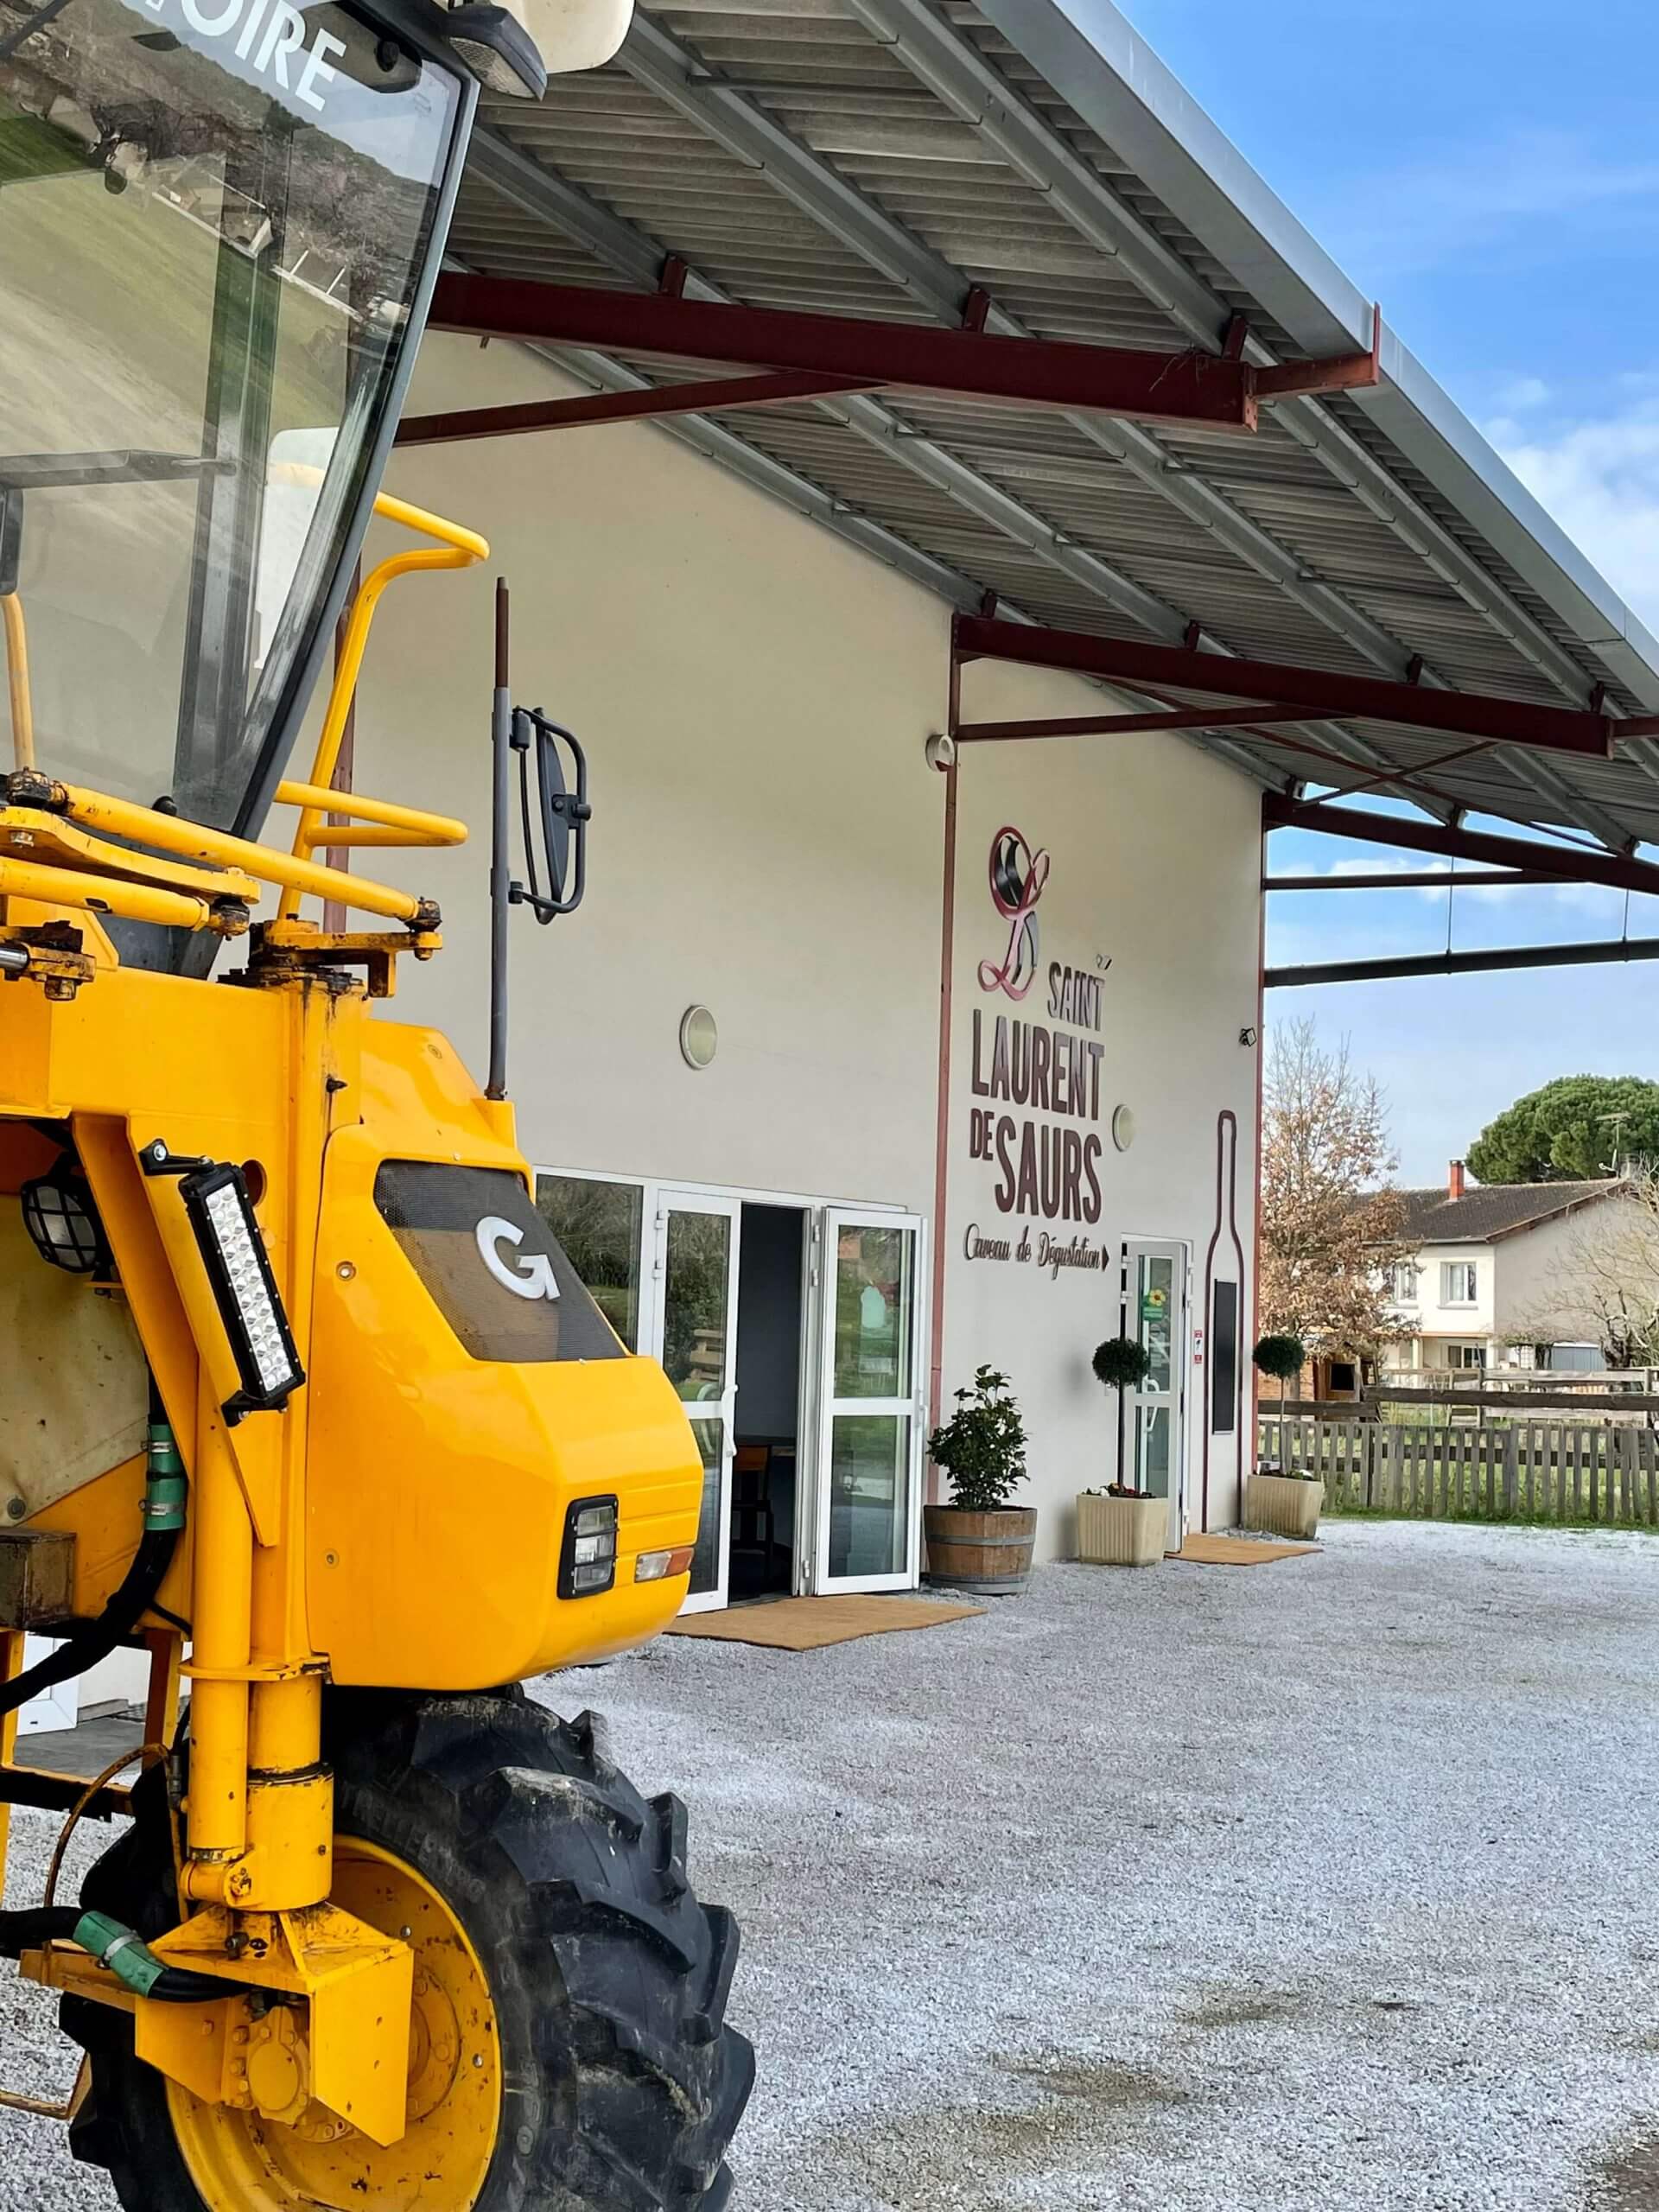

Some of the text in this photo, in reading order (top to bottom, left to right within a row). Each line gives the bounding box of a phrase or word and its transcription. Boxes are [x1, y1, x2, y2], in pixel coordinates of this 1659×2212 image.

[144, 0, 346, 111] OIRE
[1047, 962, 1105, 1031] SAINT
[971, 1009, 1104, 1120] LAURENT
[969, 1108, 1102, 1224] DE SAURS
[475, 1216, 561, 1300] G
[963, 1224, 1101, 1281] Caveau de Dégustation
